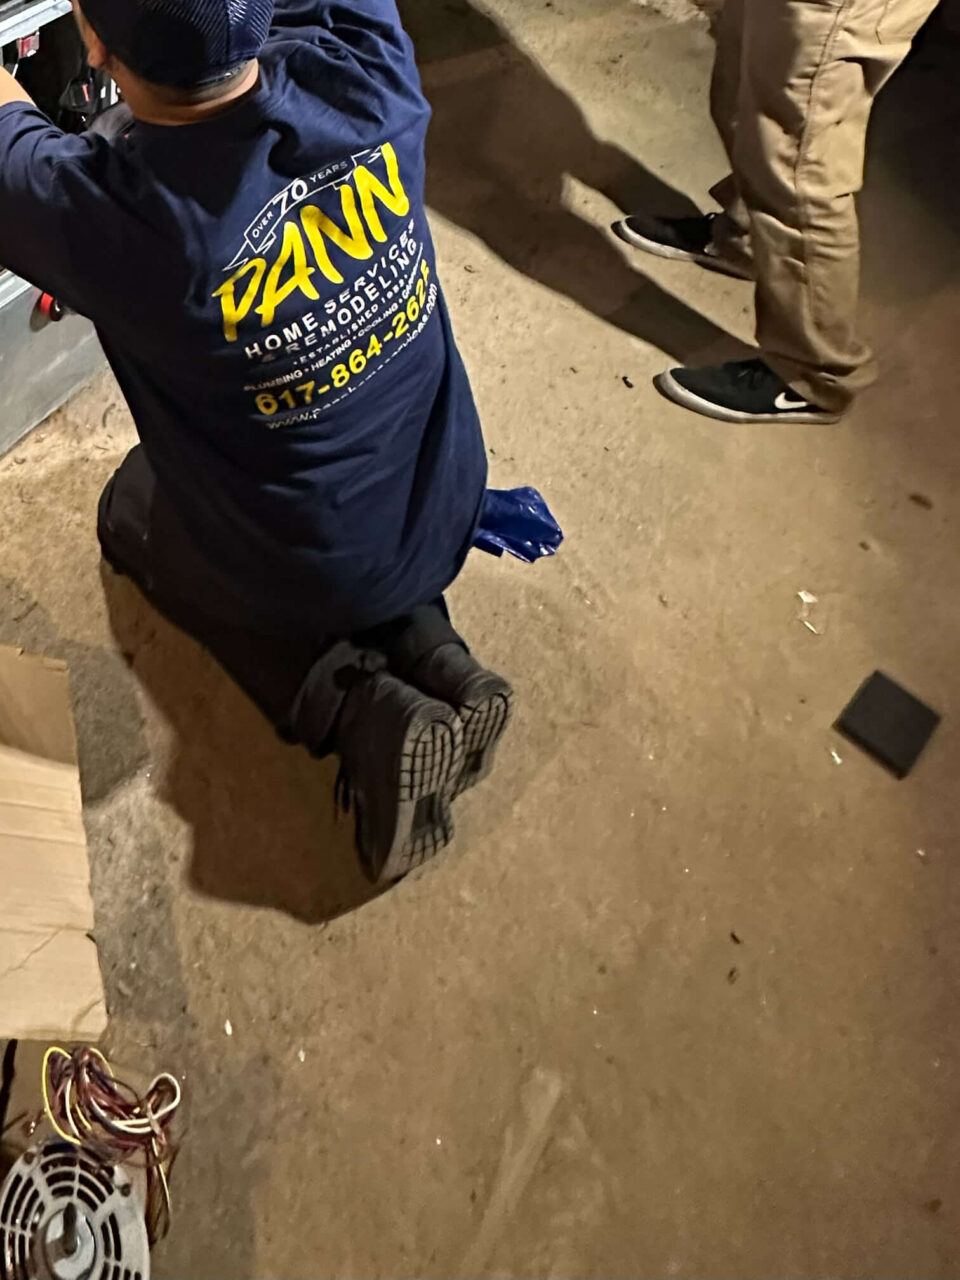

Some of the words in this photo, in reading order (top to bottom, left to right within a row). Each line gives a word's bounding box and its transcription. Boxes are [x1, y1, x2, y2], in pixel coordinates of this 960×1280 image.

[211, 141, 411, 342] PANN
[252, 210, 274, 238] OVER
[272, 179, 308, 216] 70
[309, 161, 348, 183] YEARS
[244, 311, 319, 358] HOME
[324, 218, 415, 314] SERVICES
[285, 238, 417, 353] REMODELING
[300, 303, 379, 363] ESTABLISHED
[311, 339, 352, 371] HEATING
